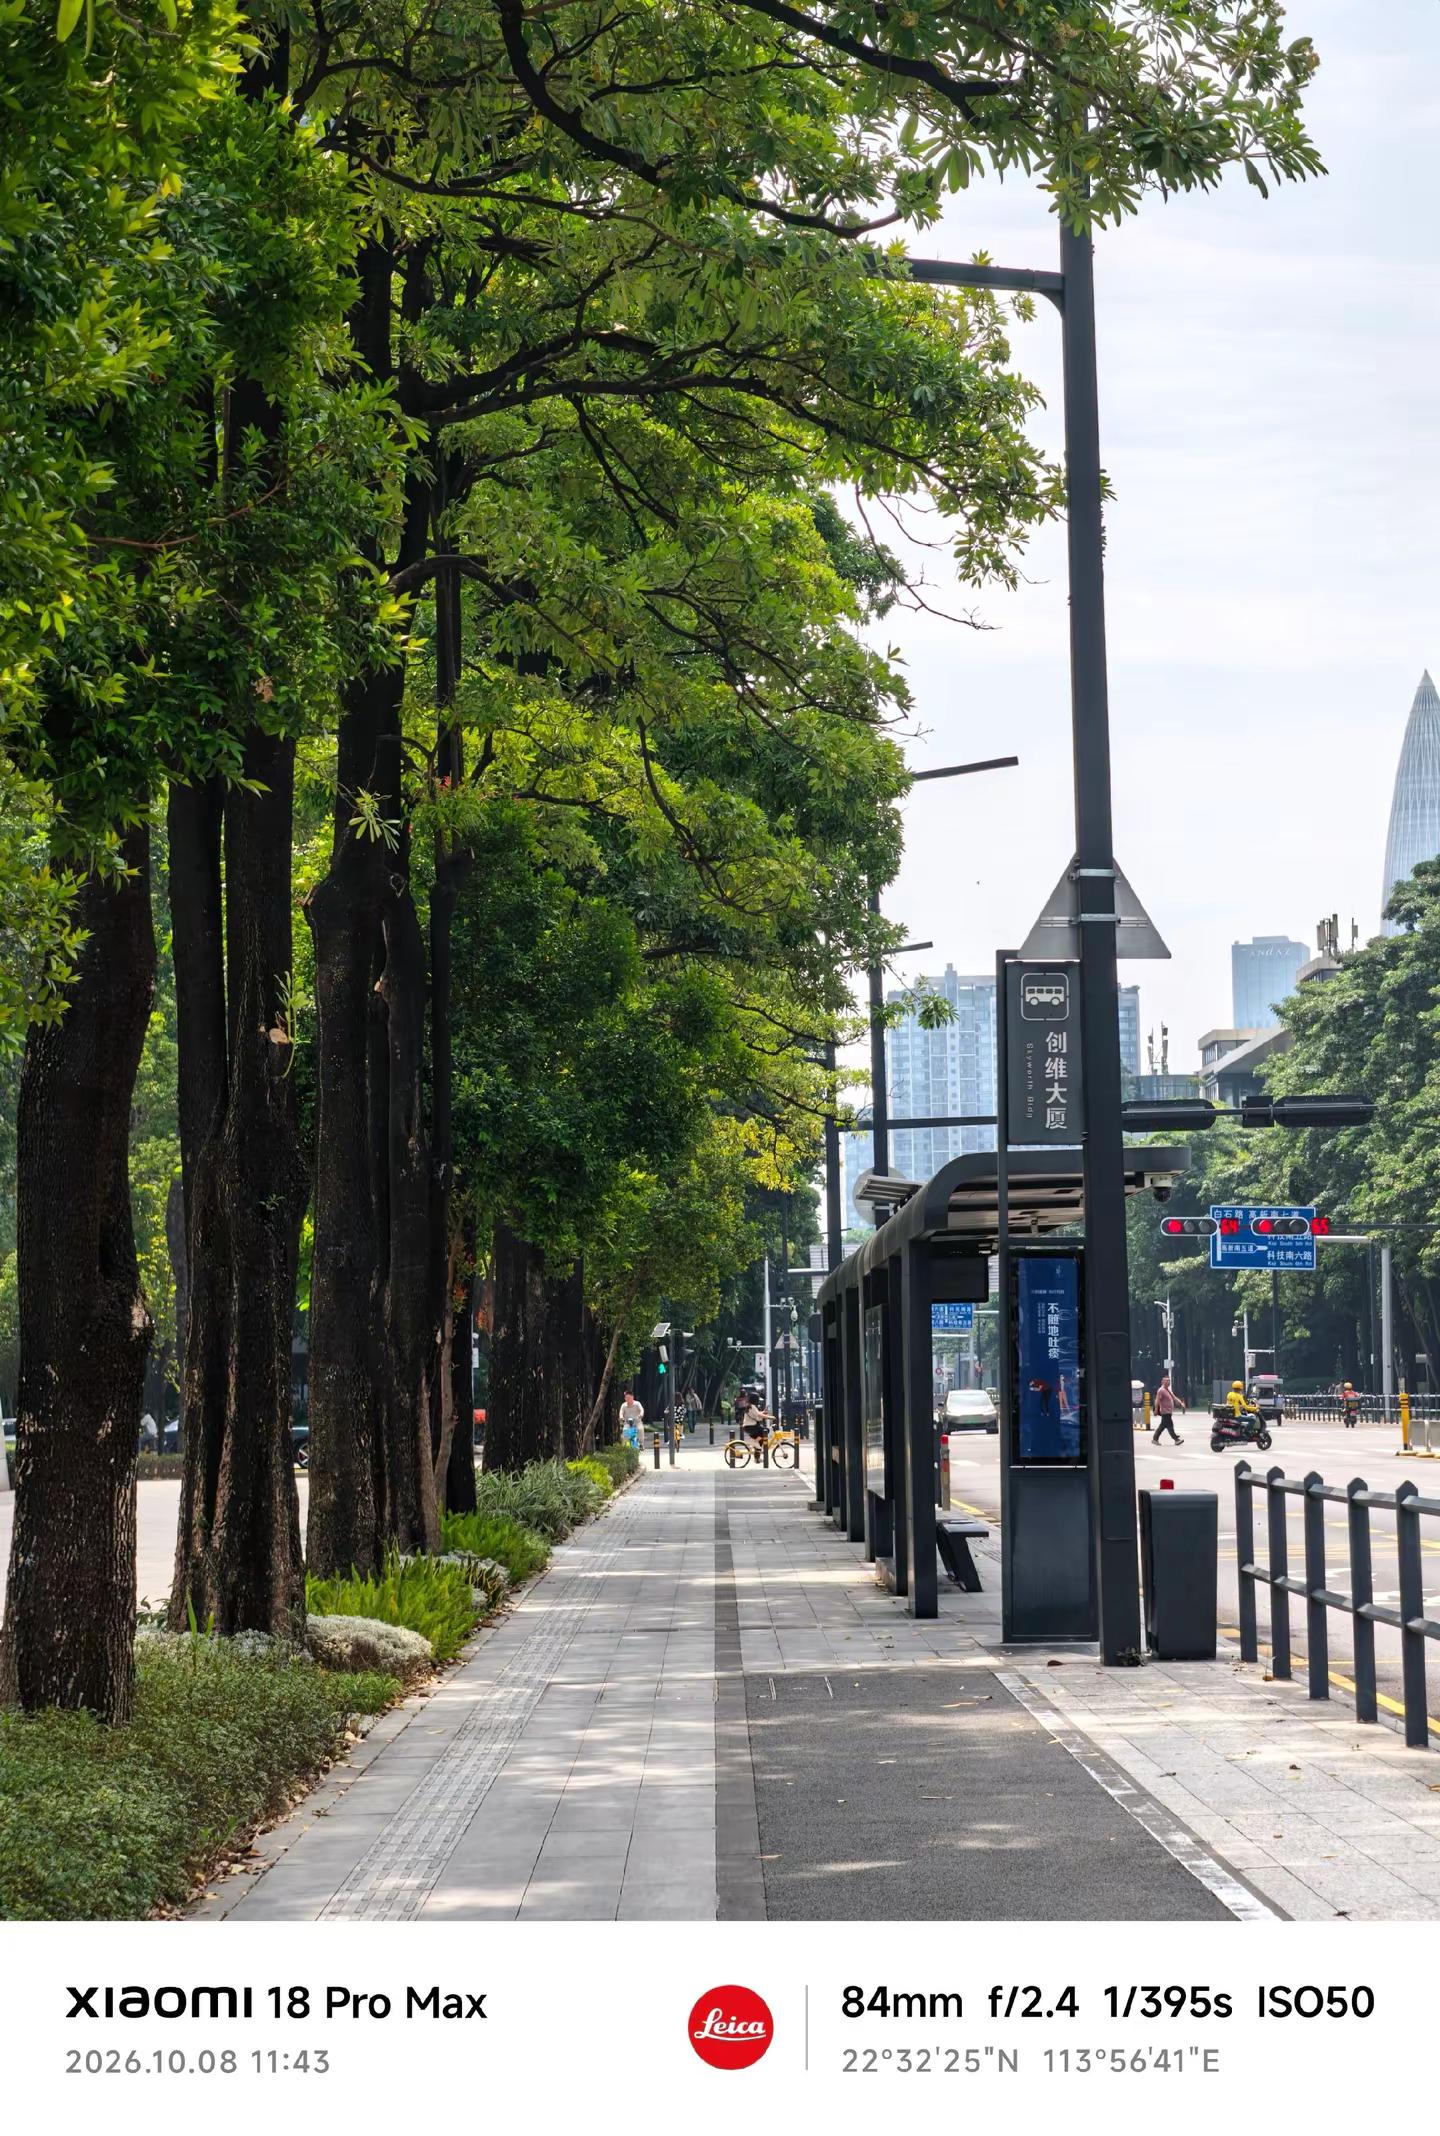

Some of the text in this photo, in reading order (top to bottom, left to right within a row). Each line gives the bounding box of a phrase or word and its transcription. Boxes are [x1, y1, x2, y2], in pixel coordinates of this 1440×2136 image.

[1045, 1031, 1068, 1129] 创维大厦
[1214, 1209, 1243, 1219] 白石路
[1267, 1250, 1312, 1261] 科技南六路
[1047, 1302, 1060, 1360] 不随地吐痰
